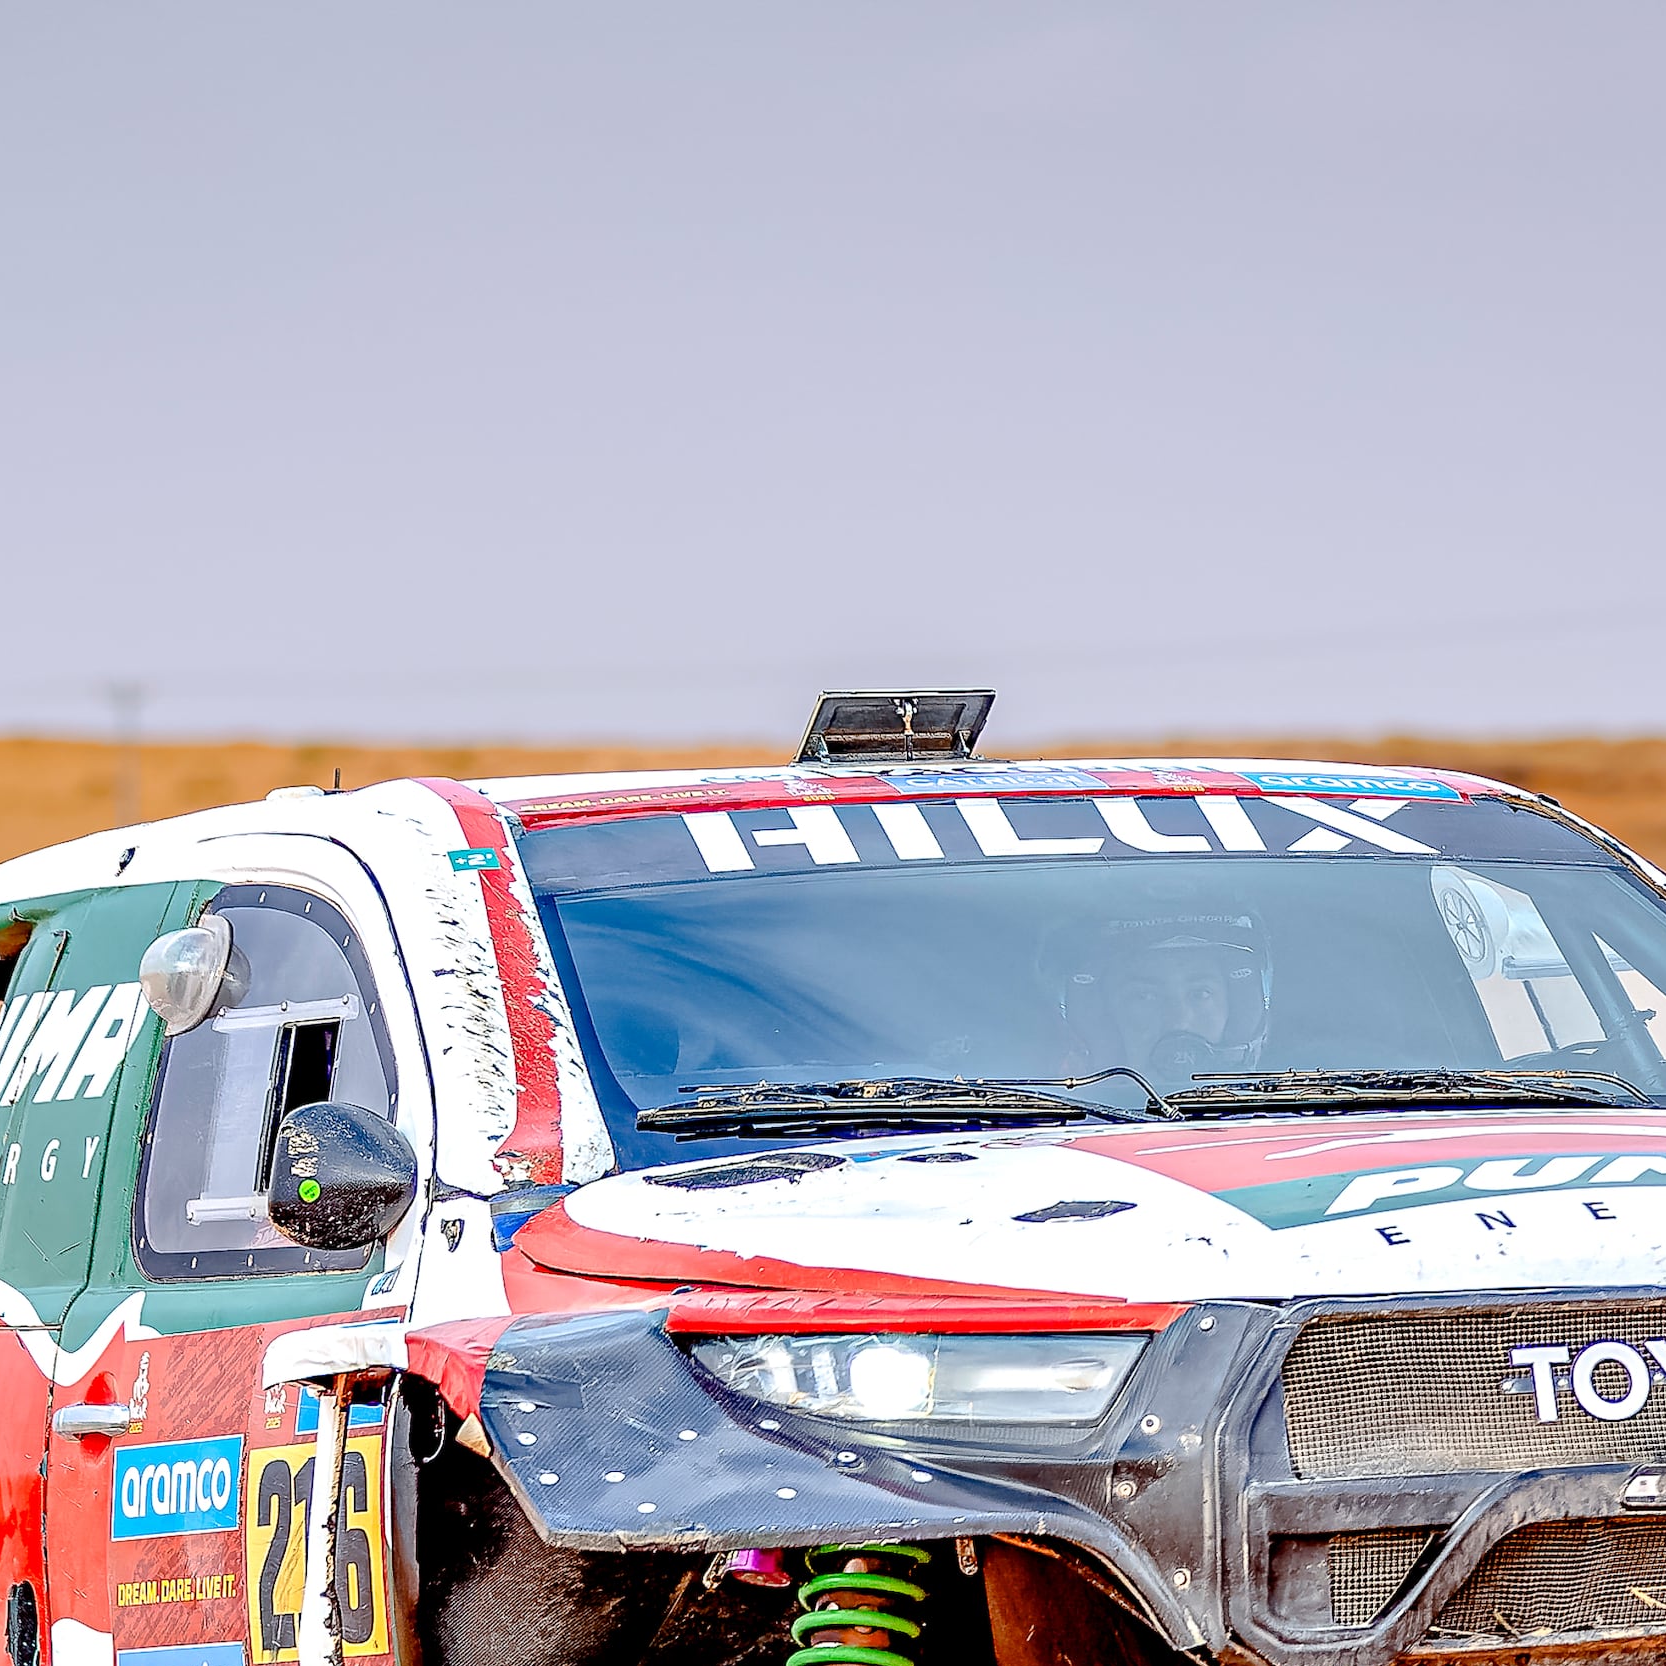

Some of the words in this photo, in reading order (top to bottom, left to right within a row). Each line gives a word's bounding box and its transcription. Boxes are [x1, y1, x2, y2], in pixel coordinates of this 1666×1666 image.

[1258, 774, 1441, 793] aramco
[680, 796, 1442, 873] HILUX
[121, 1457, 232, 1519] aramco
[117, 1580, 160, 1607] DREAM.
[160, 1577, 195, 1603] DARE.
[195, 1574, 221, 1601] LIVE
[222, 1573, 237, 1599] IT.
